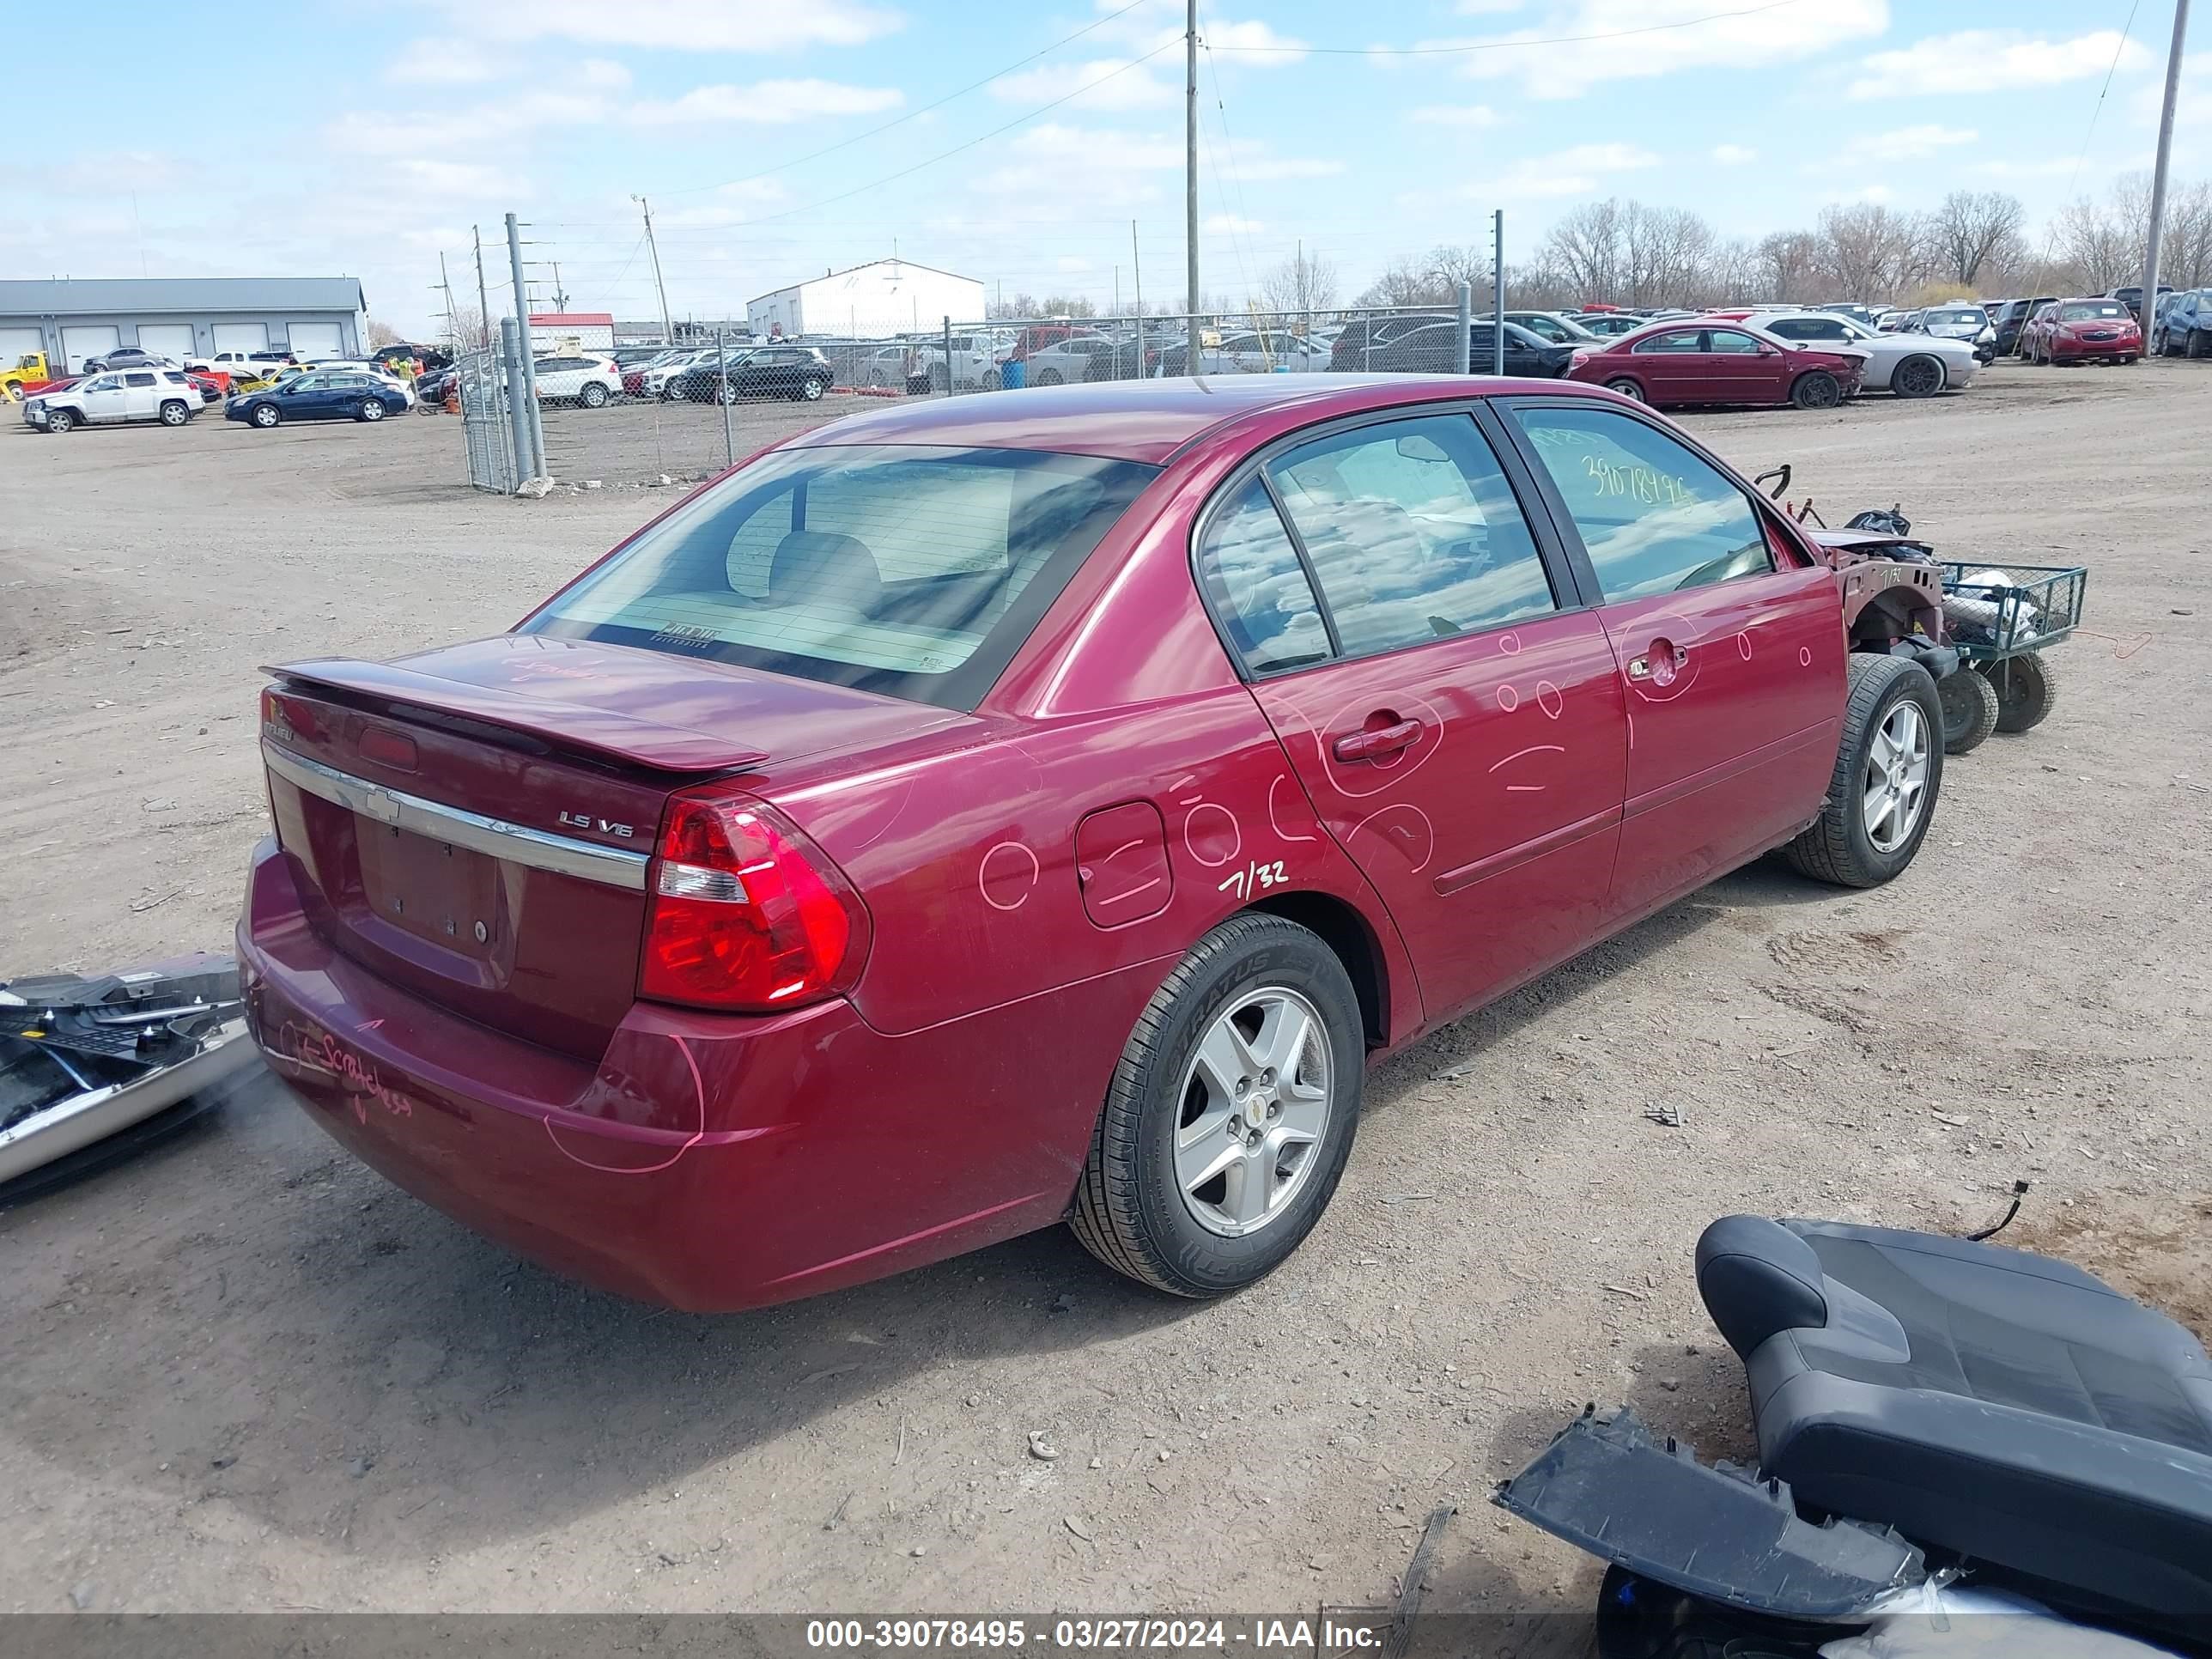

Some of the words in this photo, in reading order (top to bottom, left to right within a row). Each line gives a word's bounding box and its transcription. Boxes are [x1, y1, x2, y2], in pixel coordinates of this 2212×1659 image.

[1880, 567, 1902, 589] 7/32
[559, 811, 591, 828] LS
[598, 818, 634, 837] V6
[1218, 860, 1289, 901] 7/32
[1166, 952, 1271, 1083] STRATUS
